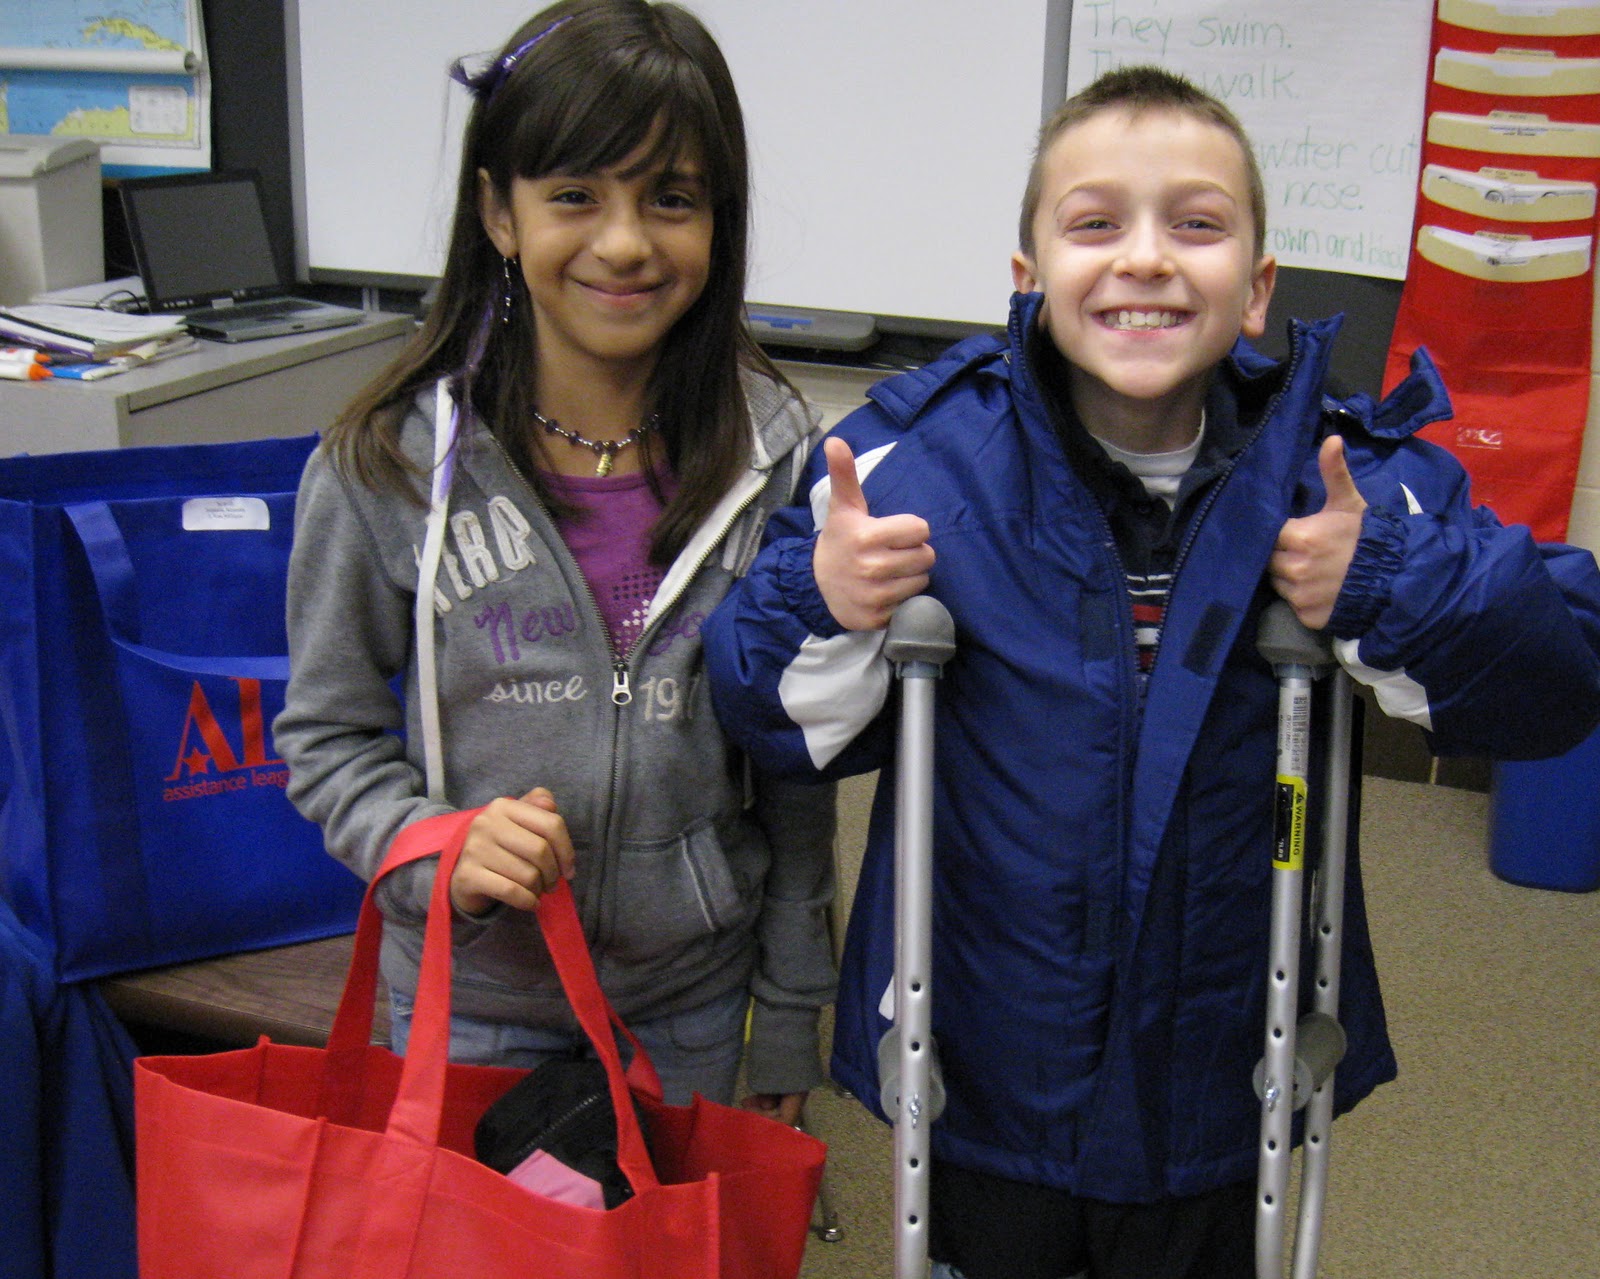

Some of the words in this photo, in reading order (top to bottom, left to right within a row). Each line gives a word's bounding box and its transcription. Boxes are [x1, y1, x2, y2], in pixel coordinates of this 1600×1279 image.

[1084, 0, 1173, 56] They
[1189, 13, 1292, 49] swim.
[1260, 125, 1359, 169] water
[1282, 180, 1364, 211] nose.
[474, 600, 575, 664] New
[483, 675, 588, 704] since
[163, 775, 247, 802] assistance
[251, 768, 292, 789] leag
[1293, 805, 1303, 856] WARNING
